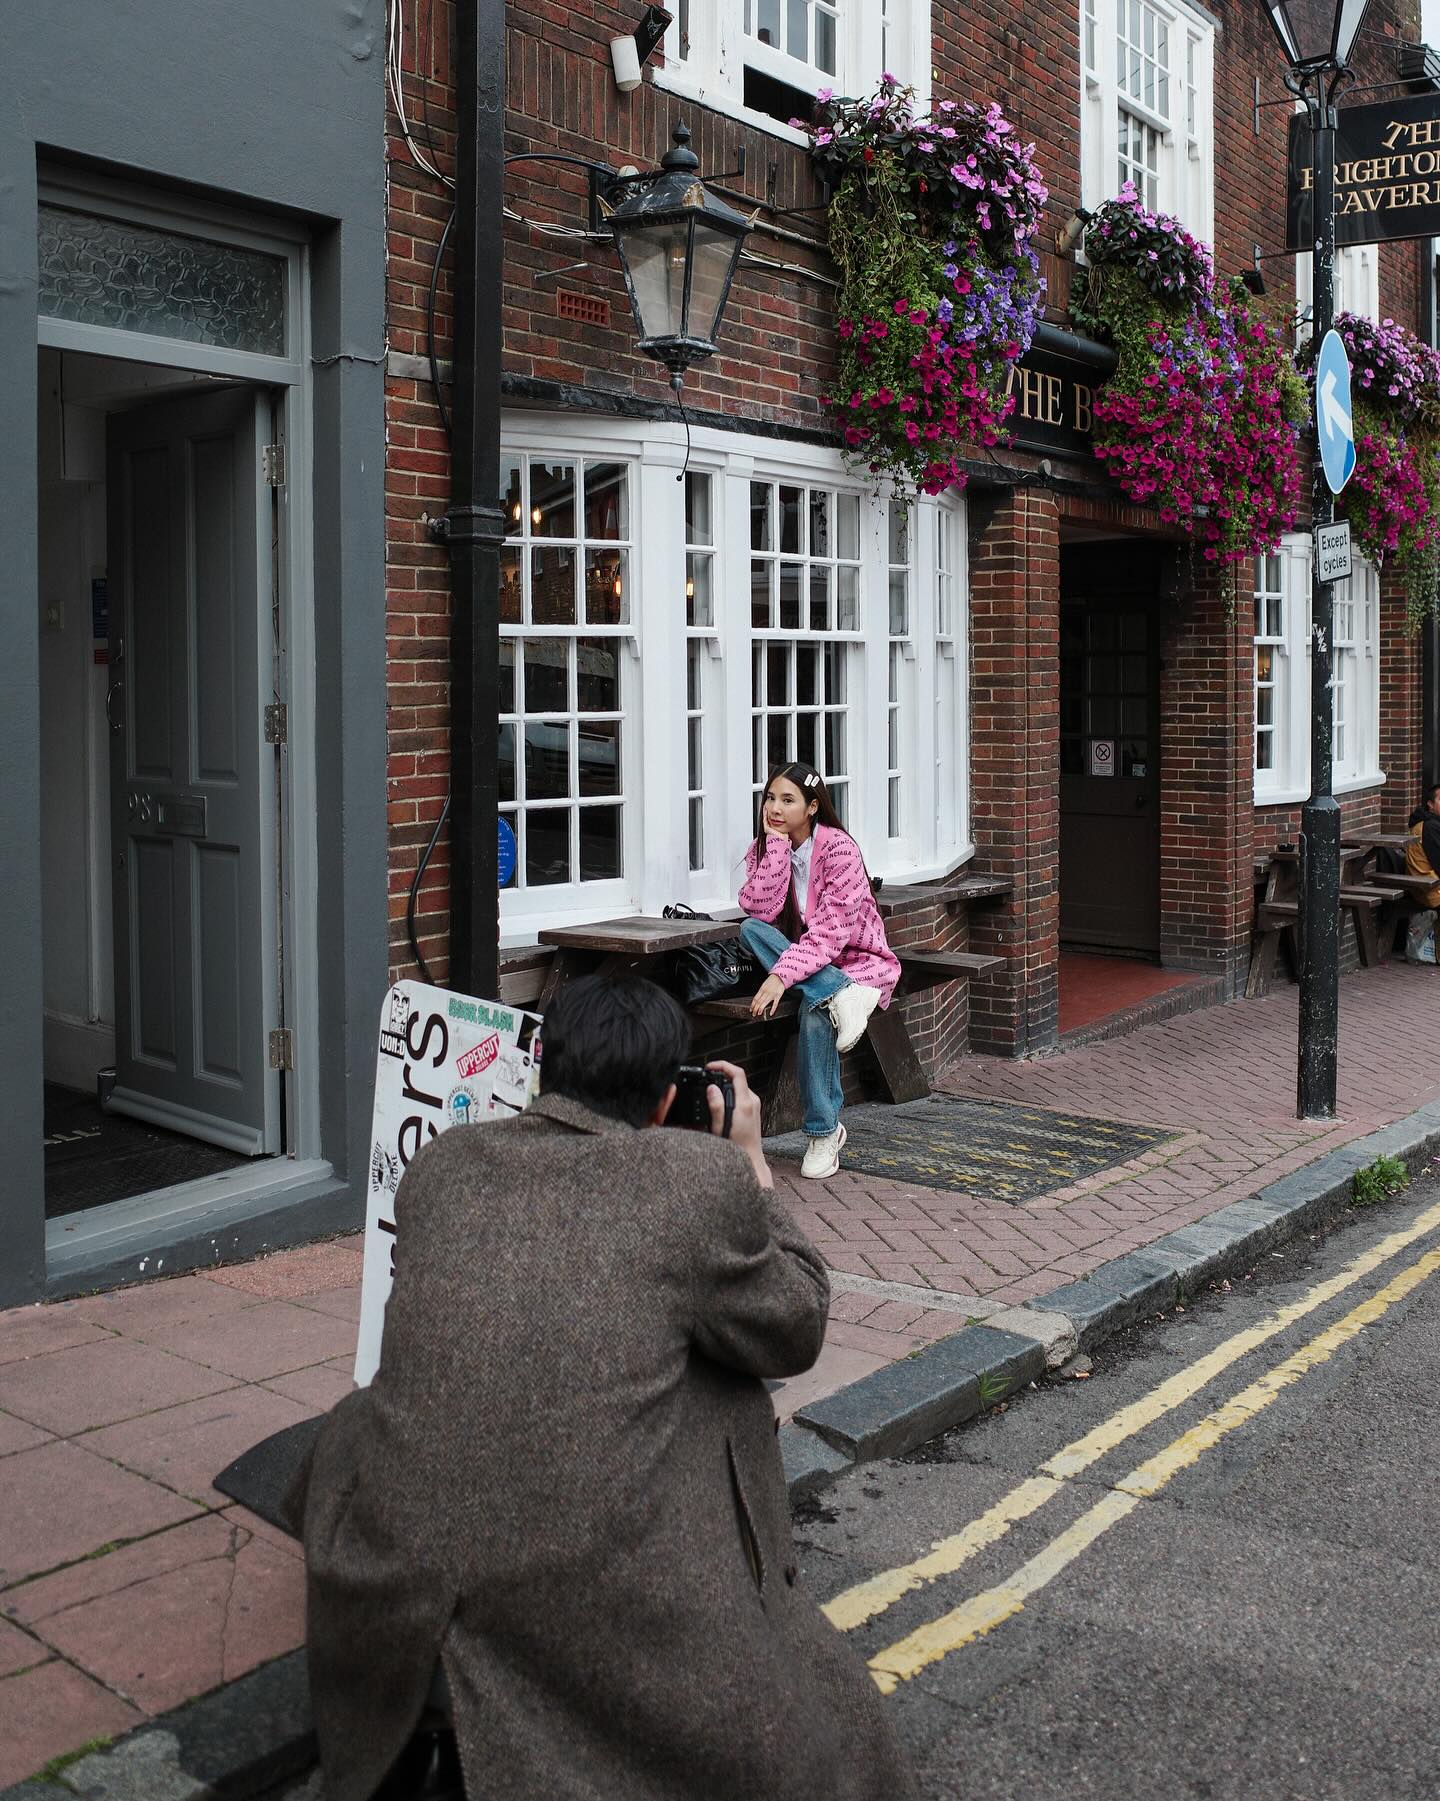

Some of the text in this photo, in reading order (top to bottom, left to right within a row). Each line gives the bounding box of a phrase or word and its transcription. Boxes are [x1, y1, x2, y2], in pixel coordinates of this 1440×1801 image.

[1300, 150, 1440, 191] BIGHTO
[1330, 180, 1440, 215] AVER
[1073, 383, 1092, 432] B
[1321, 530, 1347, 551] Except
[1323, 555, 1347, 574] cycles
[457, 1034, 499, 1077] UPPERCUT
[371, 1141, 383, 1193] UPPERCUT
[388, 1154, 399, 1194] DELUXE
